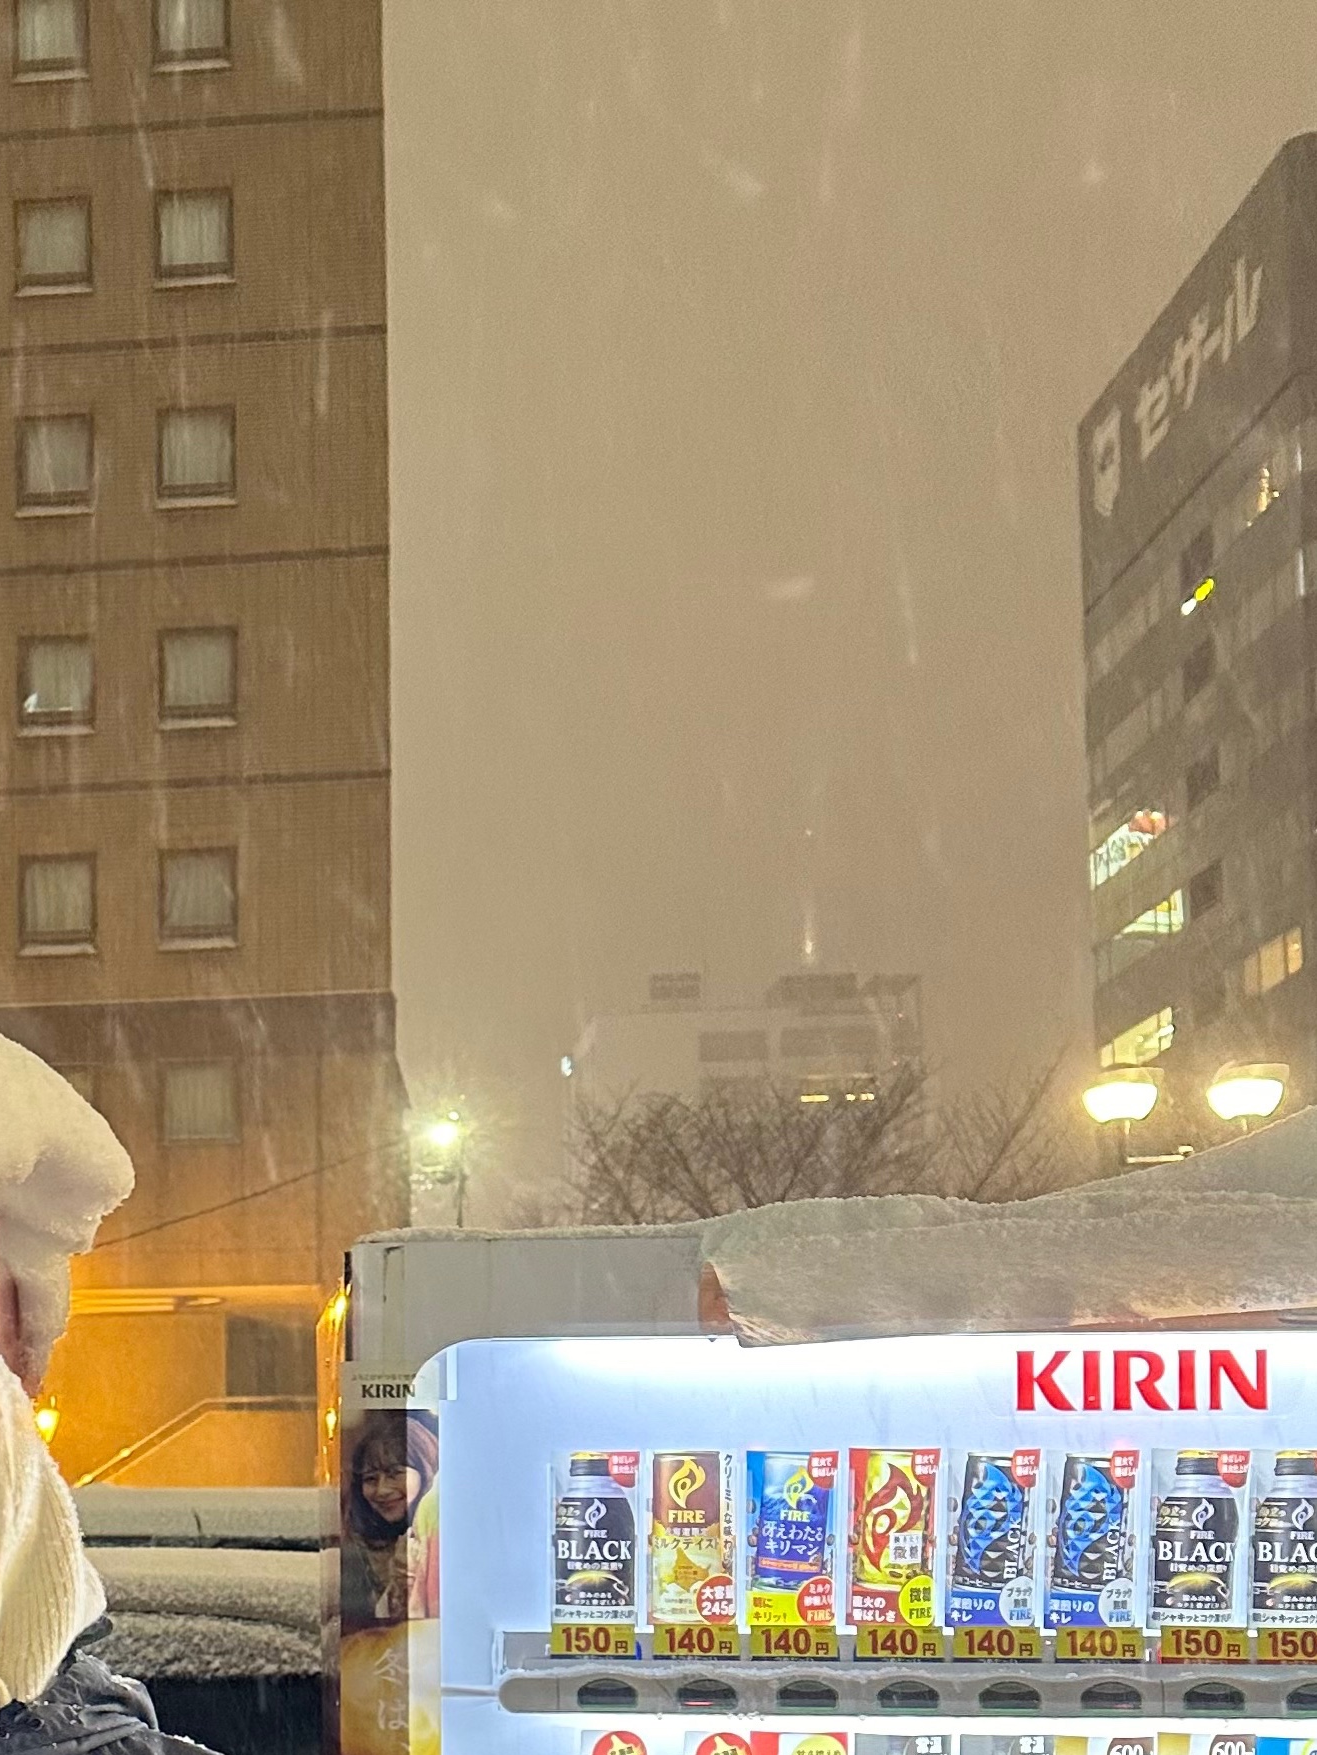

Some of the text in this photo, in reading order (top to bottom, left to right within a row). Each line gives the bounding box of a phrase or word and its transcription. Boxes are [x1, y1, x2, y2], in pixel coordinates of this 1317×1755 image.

[1015, 1349, 1269, 1412] KIRIN
[361, 1383, 416, 1399] KIRIN
[668, 1509, 706, 1524] FIRE
[779, 1511, 811, 1523] FIRE
[583, 1529, 608, 1539] FIRE
[761, 1521, 824, 1542] 冴えわたる
[557, 1540, 633, 1562] BLACK
[655, 1536, 720, 1551] ミルクテイスト
[764, 1540, 820, 1556] キリマン
[1002, 1517, 1022, 1580] BLACK
[1102, 1517, 1121, 1581] BLACK
[809, 1583, 831, 1595] ミルク
[852, 1595, 886, 1608] 直火の
[806, 1609, 831, 1623] FIRE
[908, 1607, 933, 1620] FIRE
[950, 1610, 974, 1623] キレ
[1049, 1612, 1073, 1625] キレ
[560, 1628, 629, 1655] 150円
[664, 1627, 733, 1655] 140円
[760, 1628, 830, 1656] 140円
[1171, 1629, 1241, 1658] 150円
